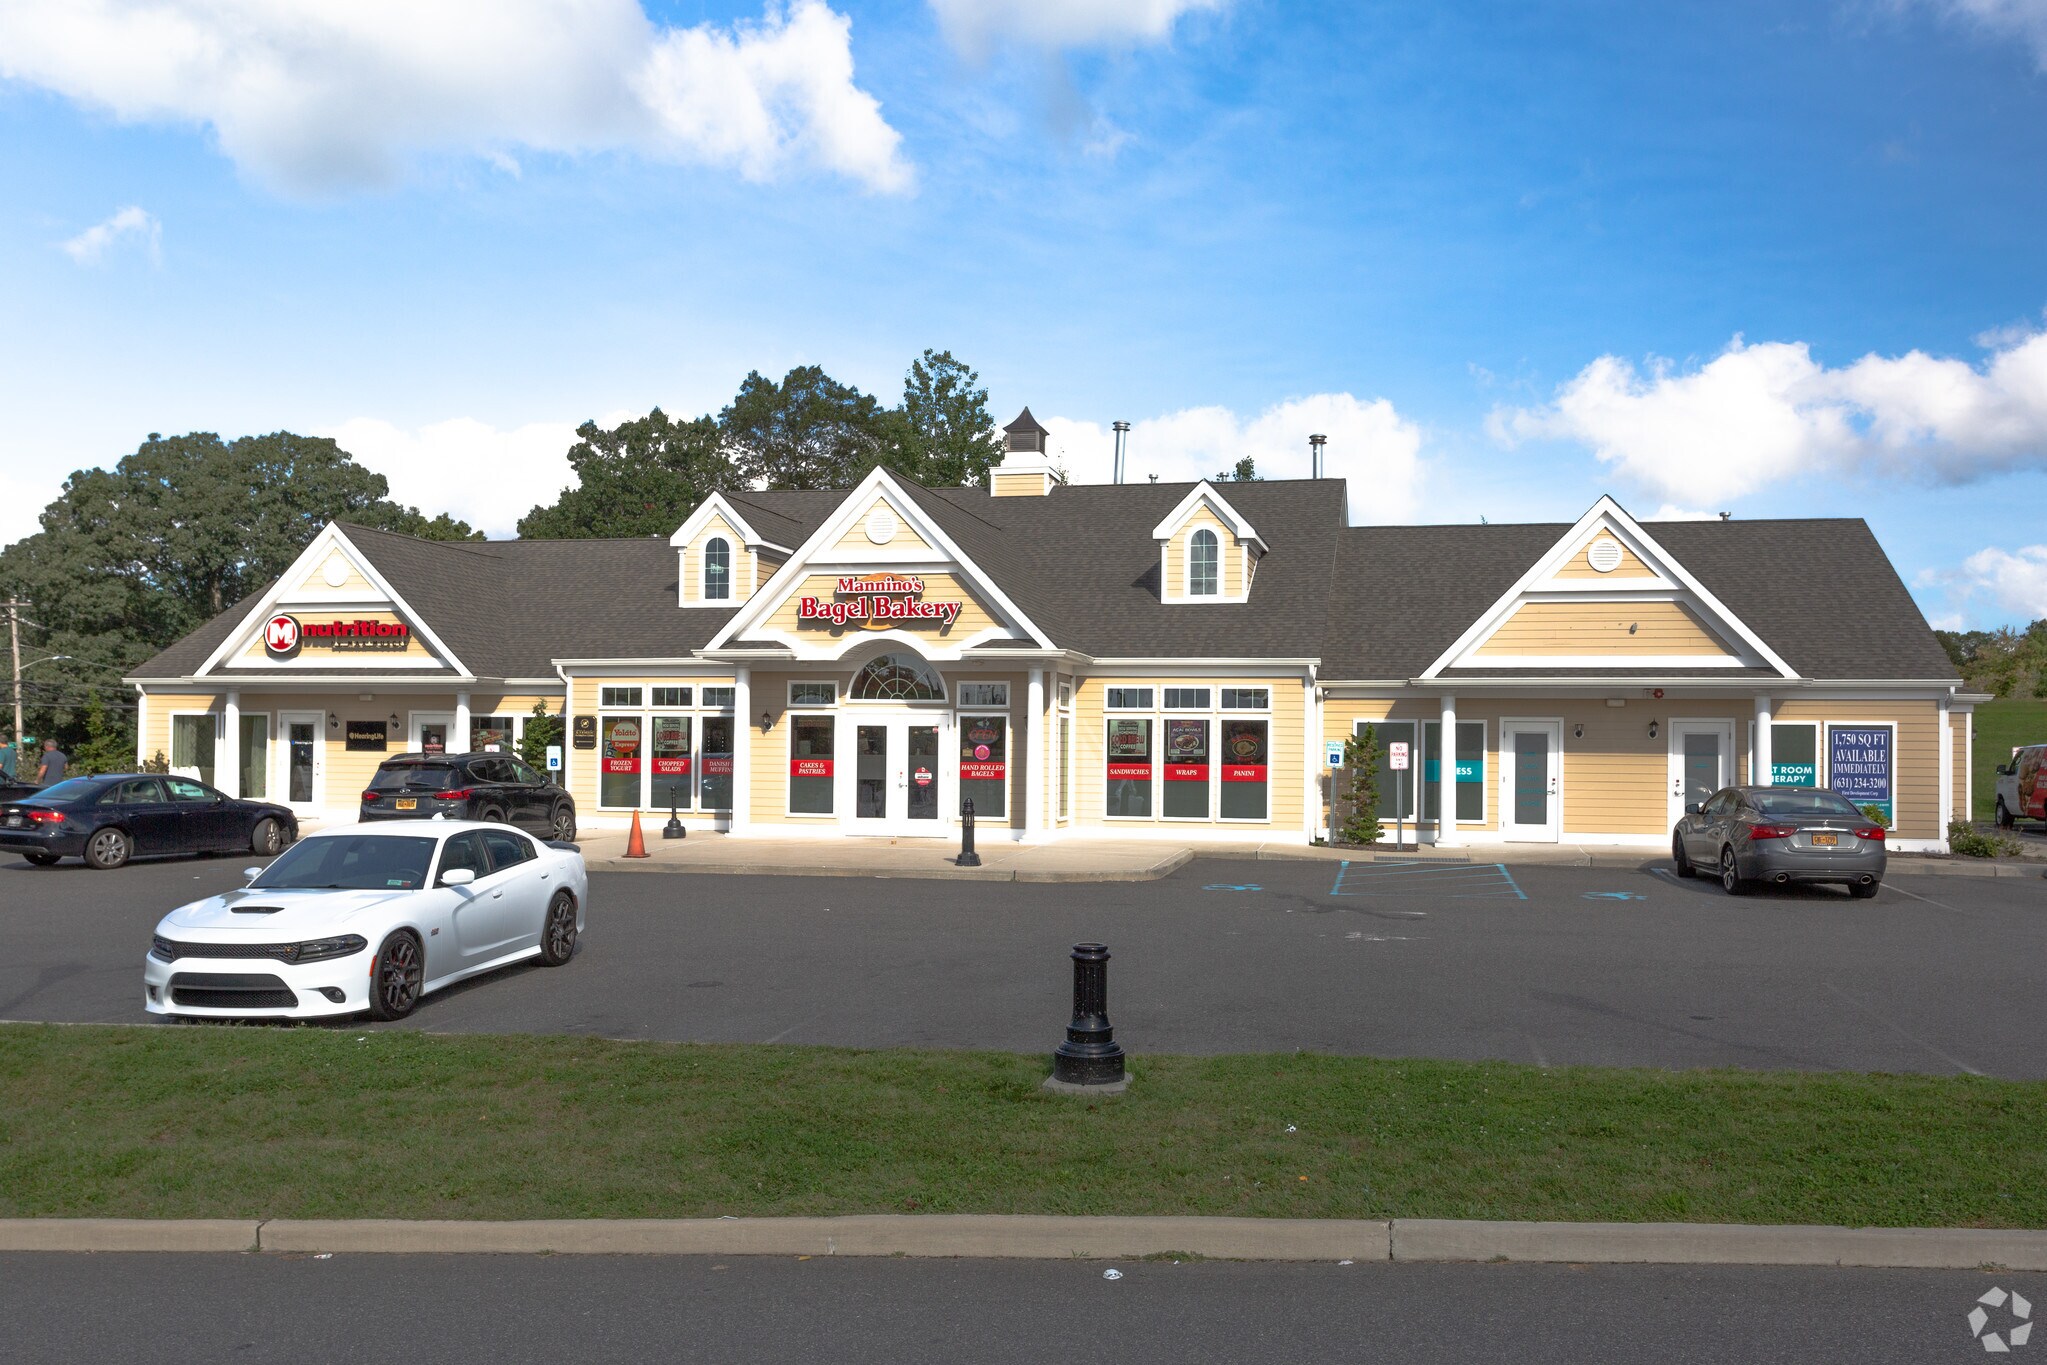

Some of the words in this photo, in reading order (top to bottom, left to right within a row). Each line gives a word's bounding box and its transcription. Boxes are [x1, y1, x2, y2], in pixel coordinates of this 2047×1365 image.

[837, 576, 924, 594] Mannino's
[800, 596, 868, 624] Bagel
[874, 596, 961, 625] Bakery
[303, 620, 408, 637] nutrition
[354, 732, 384, 741] HearingLife
[1835, 733, 1856, 747] 1,750
[1858, 733, 1872, 748] SQ
[1873, 733, 1886, 745] FT
[1834, 749, 1886, 762] AVAILABLE
[1781, 766, 1812, 774] ROOM
[1834, 763, 1886, 774] IMMEDIATELY
[1833, 777, 1853, 791] (631)
[1854, 778, 1887, 789] 234-3200
